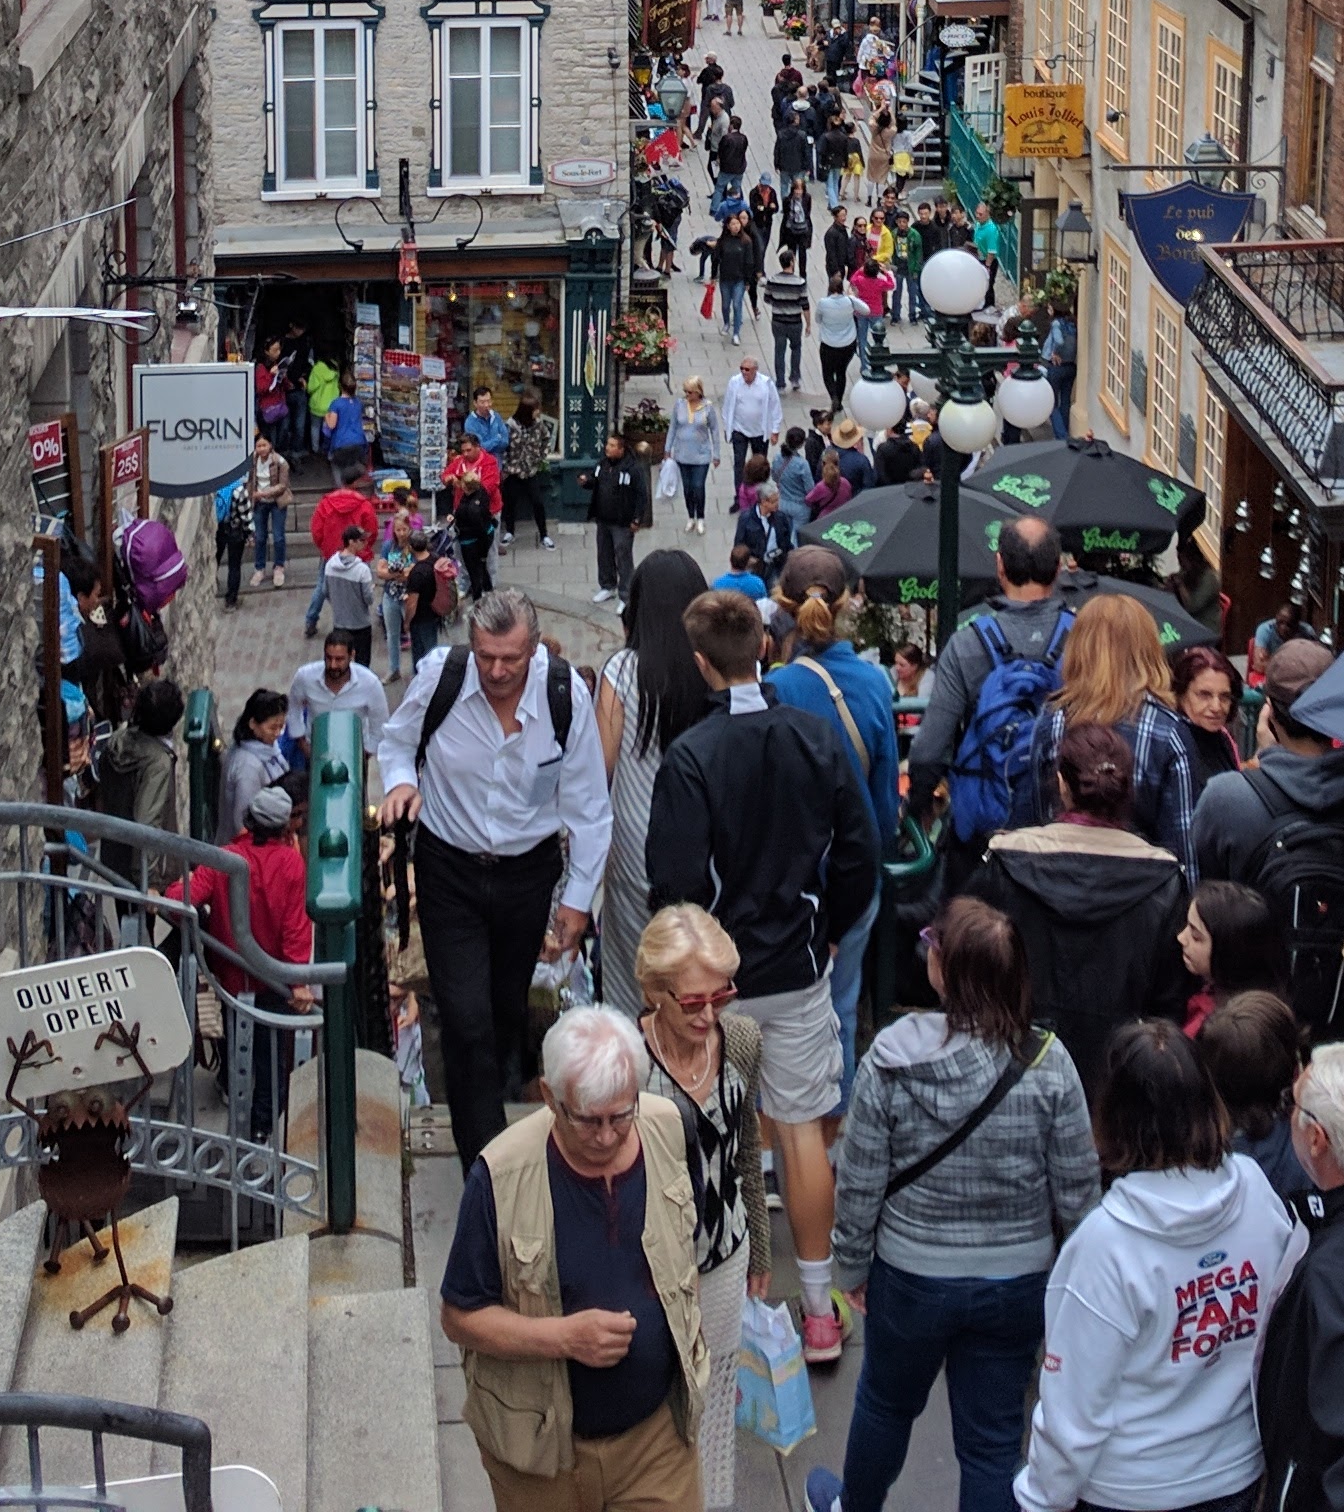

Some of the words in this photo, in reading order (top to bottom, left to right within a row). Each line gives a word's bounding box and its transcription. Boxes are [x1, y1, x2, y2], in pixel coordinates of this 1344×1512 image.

[1023, 89, 1067, 100] boutique
[1007, 106, 1045, 127] Louis
[1048, 103, 1084, 128] Jolliet
[1019, 145, 1069, 155] souvenirs
[1163, 205, 1183, 220] Le
[1187, 203, 1215, 222] pub
[1156, 244, 1202, 264] Borg
[146, 417, 243, 441] FLORIN
[117, 451, 138, 477] 25$
[1082, 526, 1140, 553] Grolsch
[16, 966, 130, 1009] OUVERT
[46, 999, 123, 1034] OPEN
[1175, 1260, 1258, 1311] MEGA
[1174, 1284, 1258, 1338] FAN
[1171, 1319, 1257, 1363] FORD
